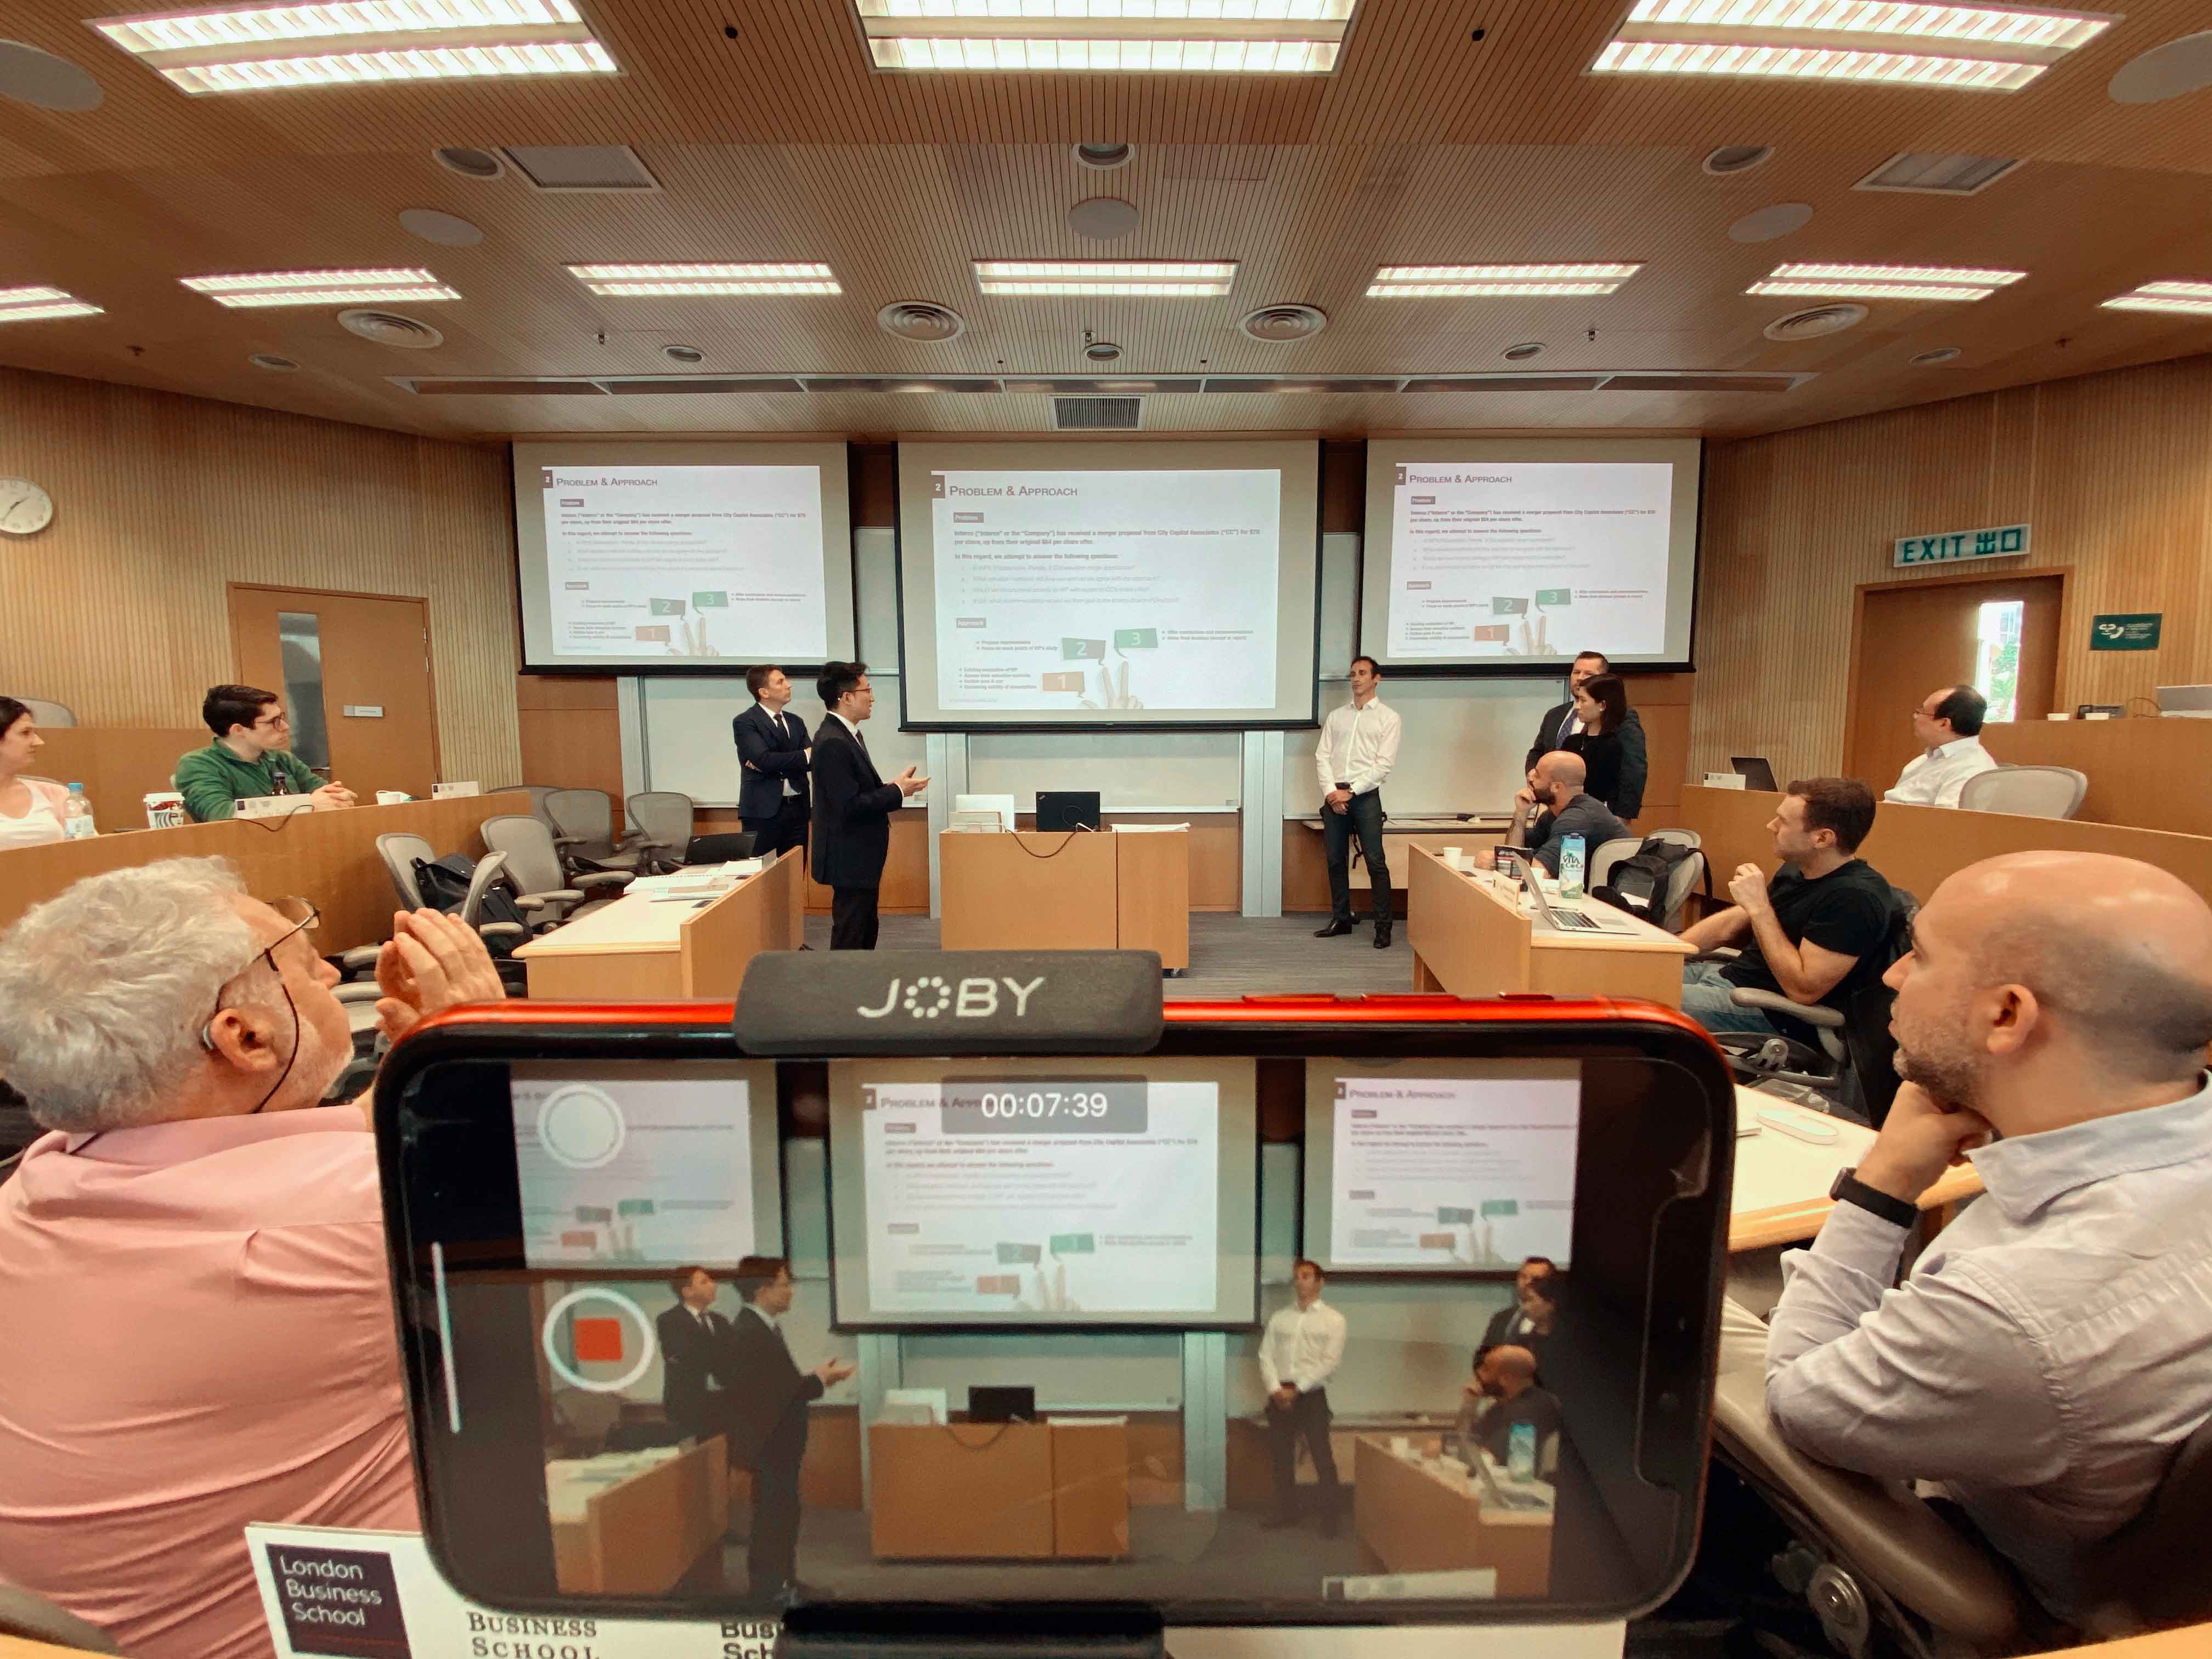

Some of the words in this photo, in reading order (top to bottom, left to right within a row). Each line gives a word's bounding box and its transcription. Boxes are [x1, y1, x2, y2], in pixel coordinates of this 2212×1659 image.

[1409, 475, 1452, 483] PROBLEM
[1465, 475, 1512, 483] APPROACH
[950, 486, 1002, 496] PROBLEM
[1006, 486, 1014, 495] &
[1019, 486, 1078, 496] APPROACH
[1903, 535, 1966, 563] EXIT
[1976, 528, 2021, 555] 出口
[1504, 600, 1513, 612] 2
[1549, 592, 1557, 602] 3
[663, 601, 671, 613] 2
[1131, 632, 1141, 646] 3
[1076, 641, 1087, 657] 2
[1058, 675, 1066, 689] 1
[1562, 855, 1581, 864] VITA
[856, 975, 1046, 1018] JOBY
[981, 1093, 1107, 1118] 00:07:39
[280, 1555, 363, 1580] London
[286, 1578, 382, 1605] Business
[292, 1602, 365, 1626] School
[466, 1611, 597, 1637] BUSINESS
[472, 1637, 599, 1659] SCHOOL
